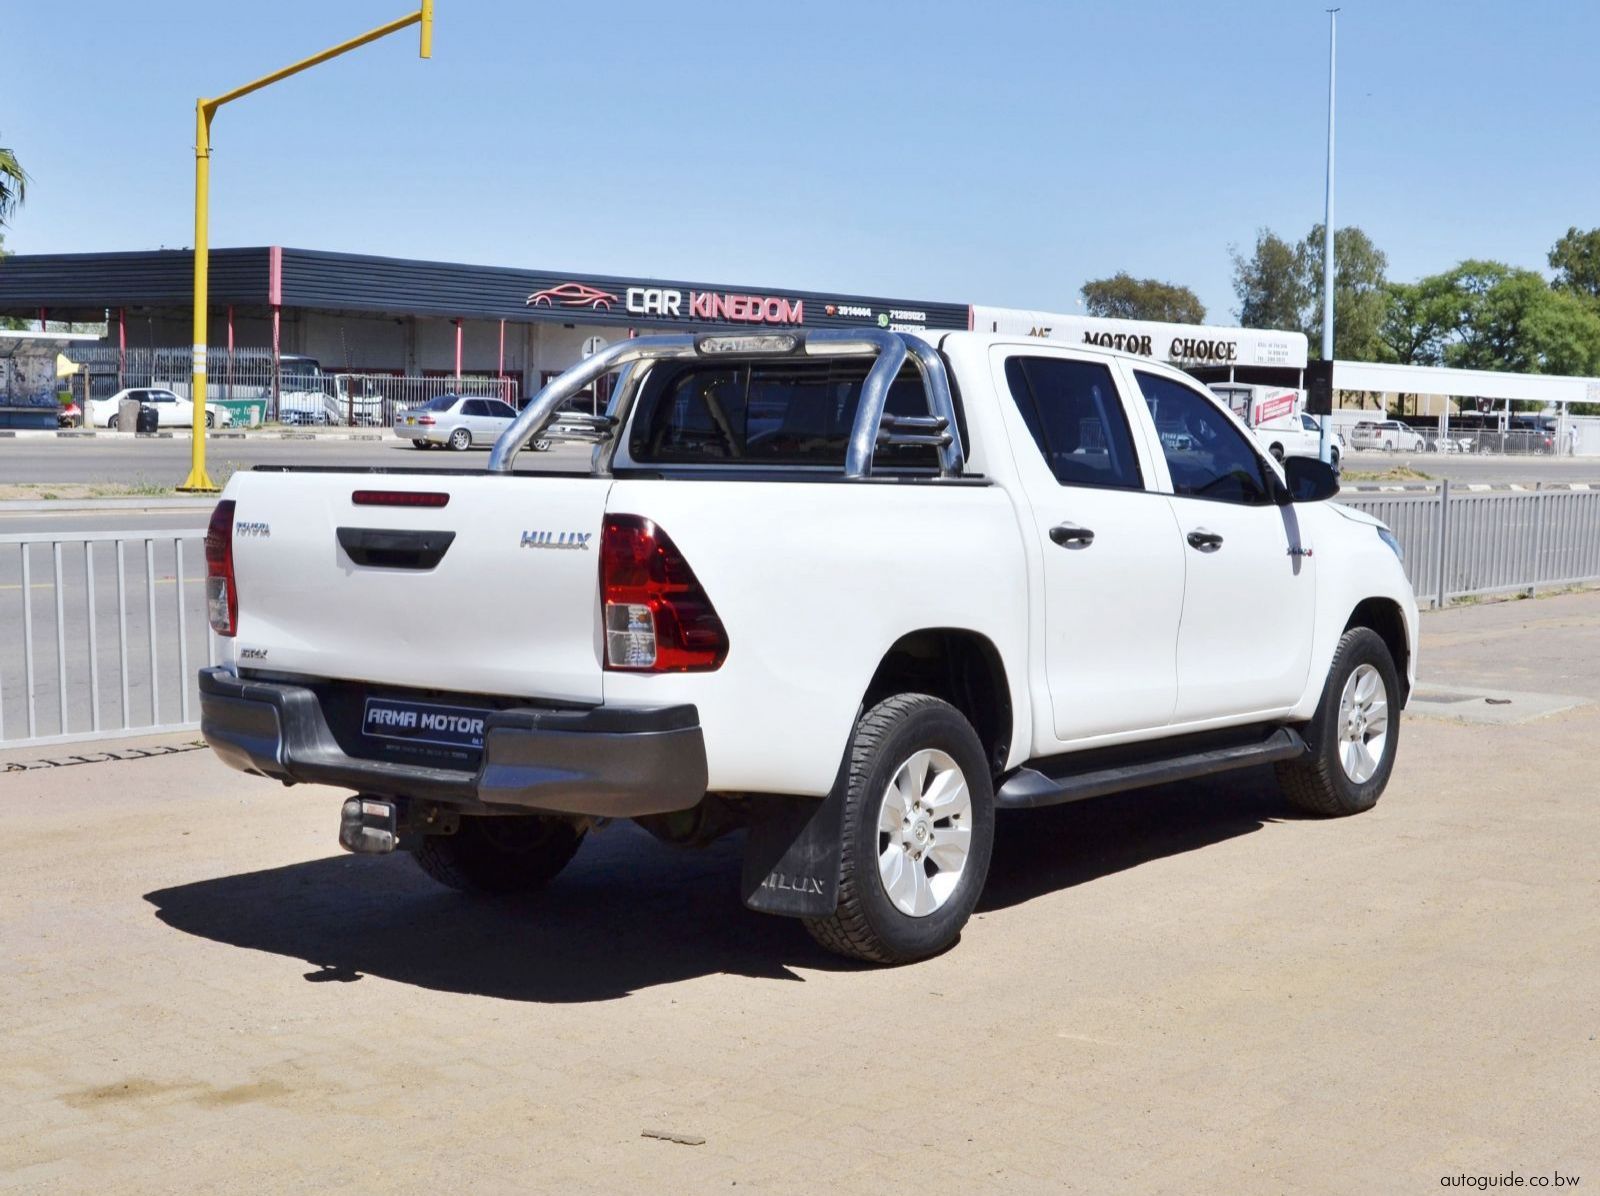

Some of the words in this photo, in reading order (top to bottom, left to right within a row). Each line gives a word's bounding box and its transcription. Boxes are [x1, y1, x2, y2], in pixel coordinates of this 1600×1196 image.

[626, 287, 681, 316] CAR
[689, 291, 803, 324] KINGDOM
[1083, 331, 1153, 356] MOTOR
[1171, 338, 1238, 361] CHOICE
[520, 531, 592, 550] HILUX
[367, 708, 417, 728] ARMA
[421, 712, 484, 735] MOTOR
